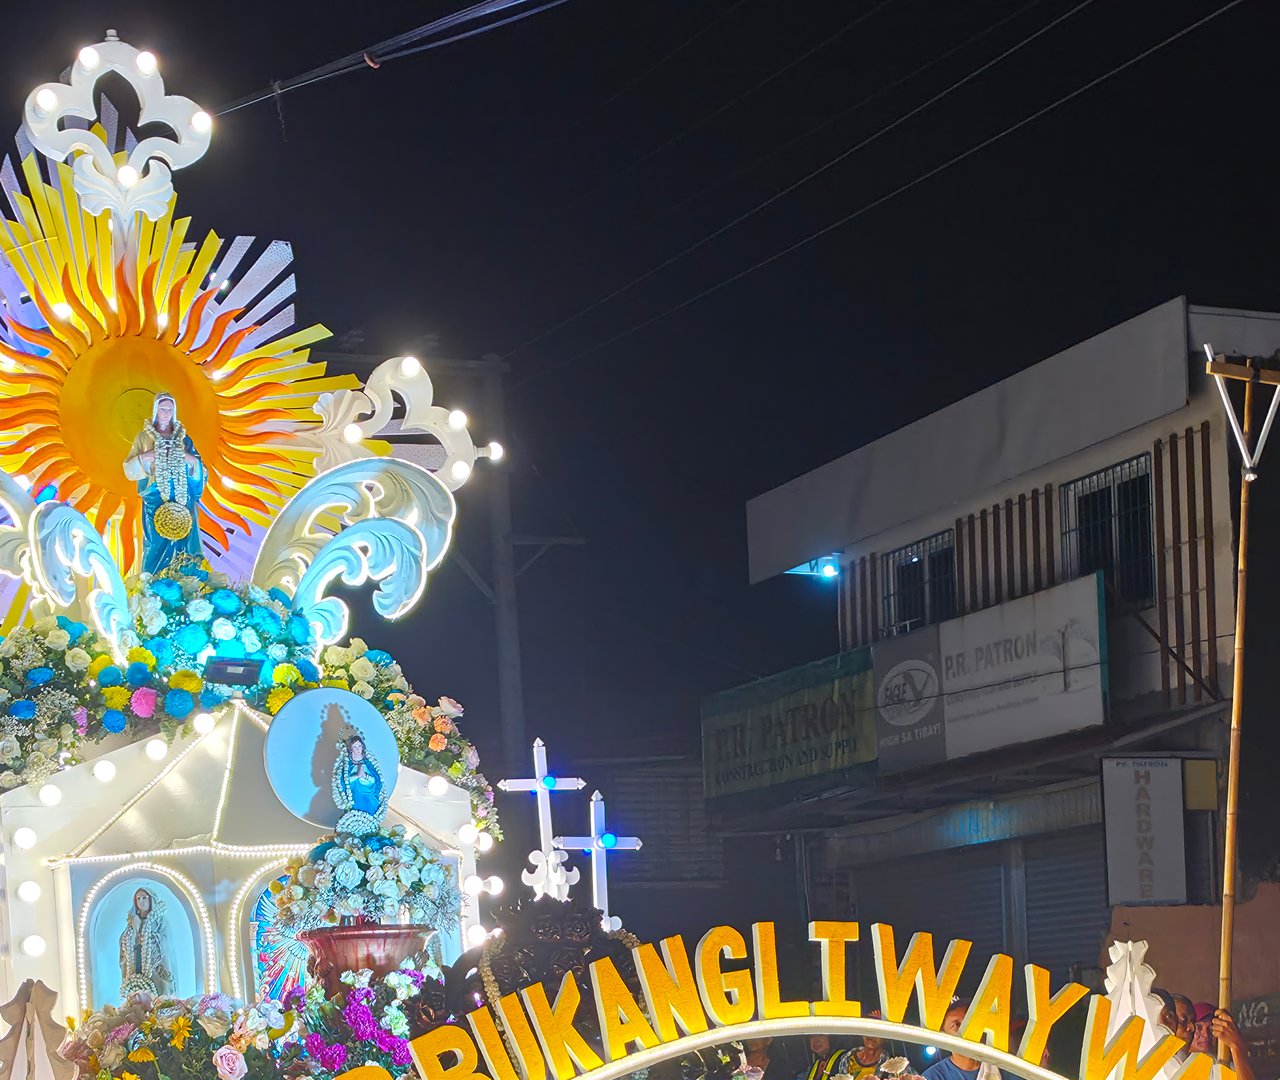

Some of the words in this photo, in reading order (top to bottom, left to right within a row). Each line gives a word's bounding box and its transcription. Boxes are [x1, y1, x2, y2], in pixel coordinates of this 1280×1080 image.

[974, 630, 1038, 670] PATRON
[761, 690, 858, 750] PATRON
[715, 756, 793, 785] CONSTRUCTION
[1133, 769, 1155, 898] HARDWARE
